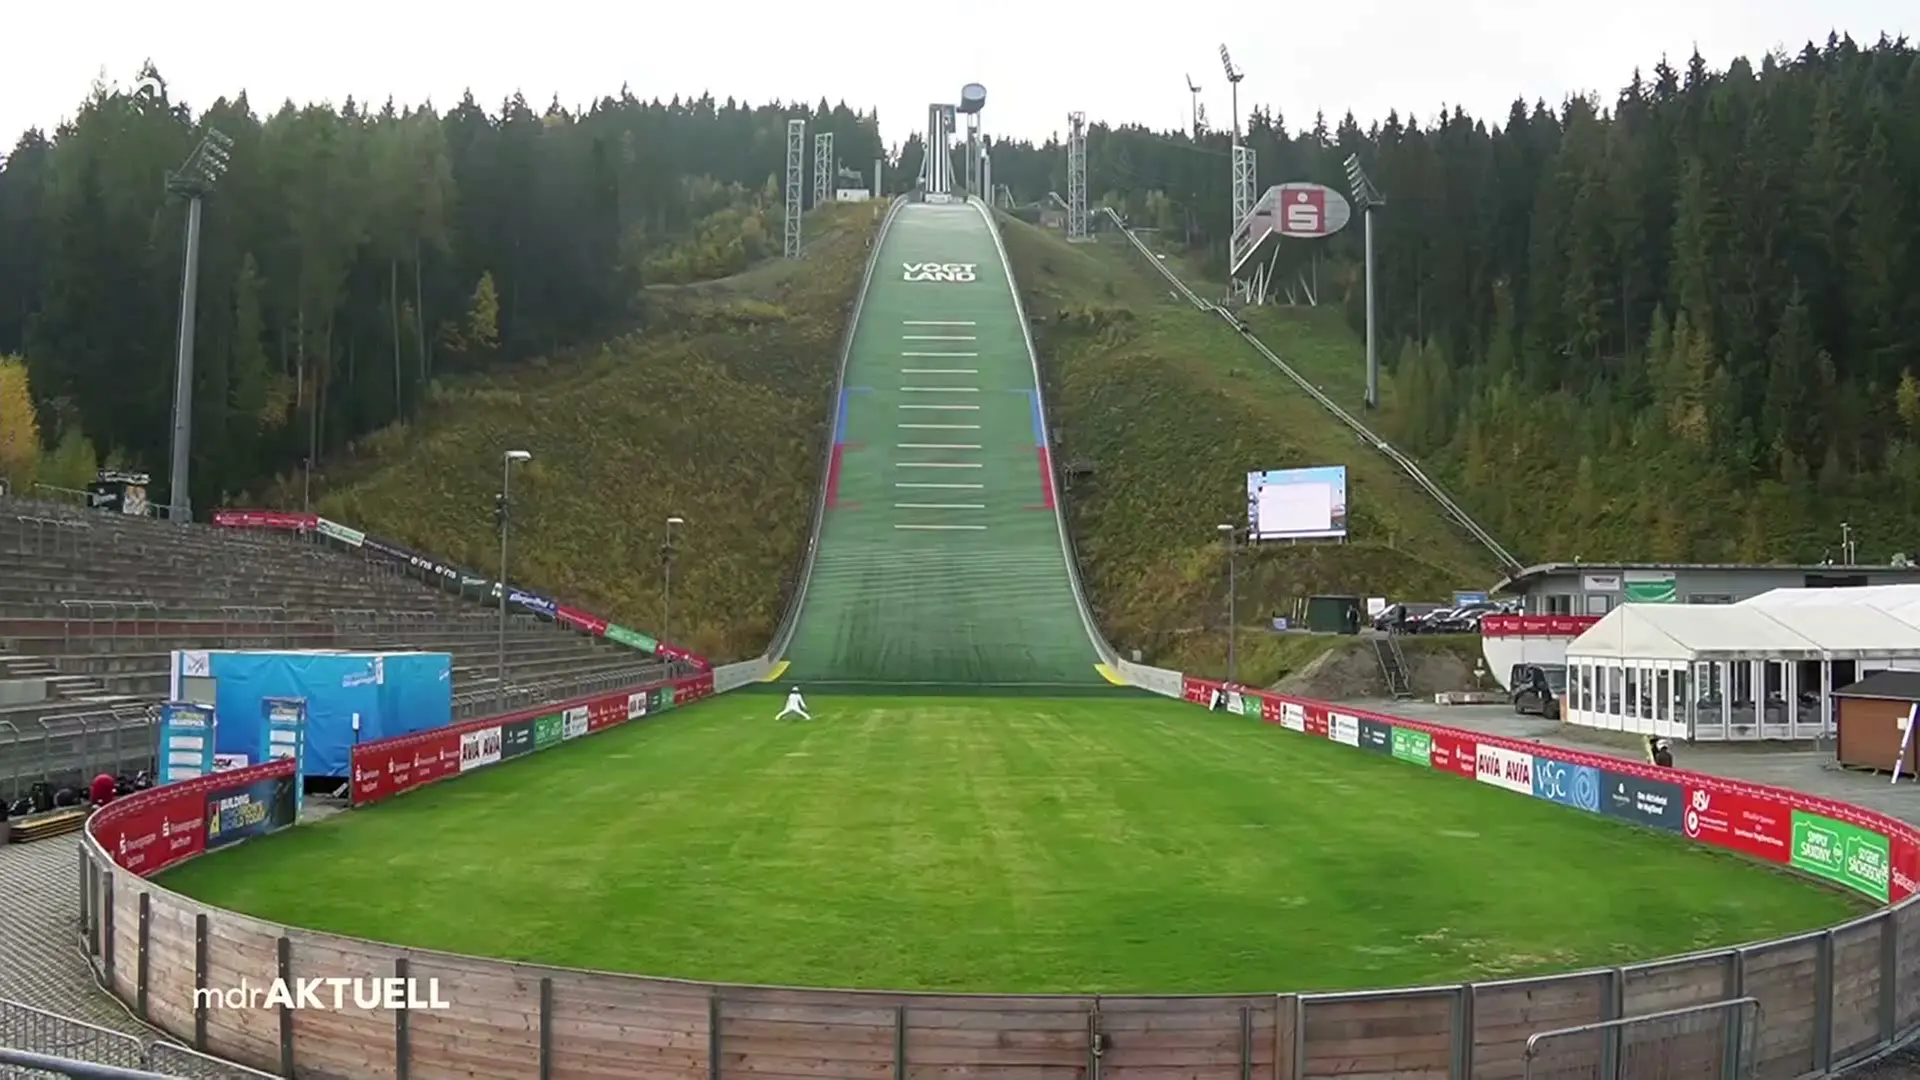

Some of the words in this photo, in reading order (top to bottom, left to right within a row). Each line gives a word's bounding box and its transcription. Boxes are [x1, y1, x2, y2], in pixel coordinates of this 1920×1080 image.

[903, 262, 977, 272] VOGT
[903, 272, 976, 281] LAND
[1478, 752, 1501, 777] AVIA
[1505, 757, 1530, 785] AVIA
[1536, 760, 1566, 799] VSC
